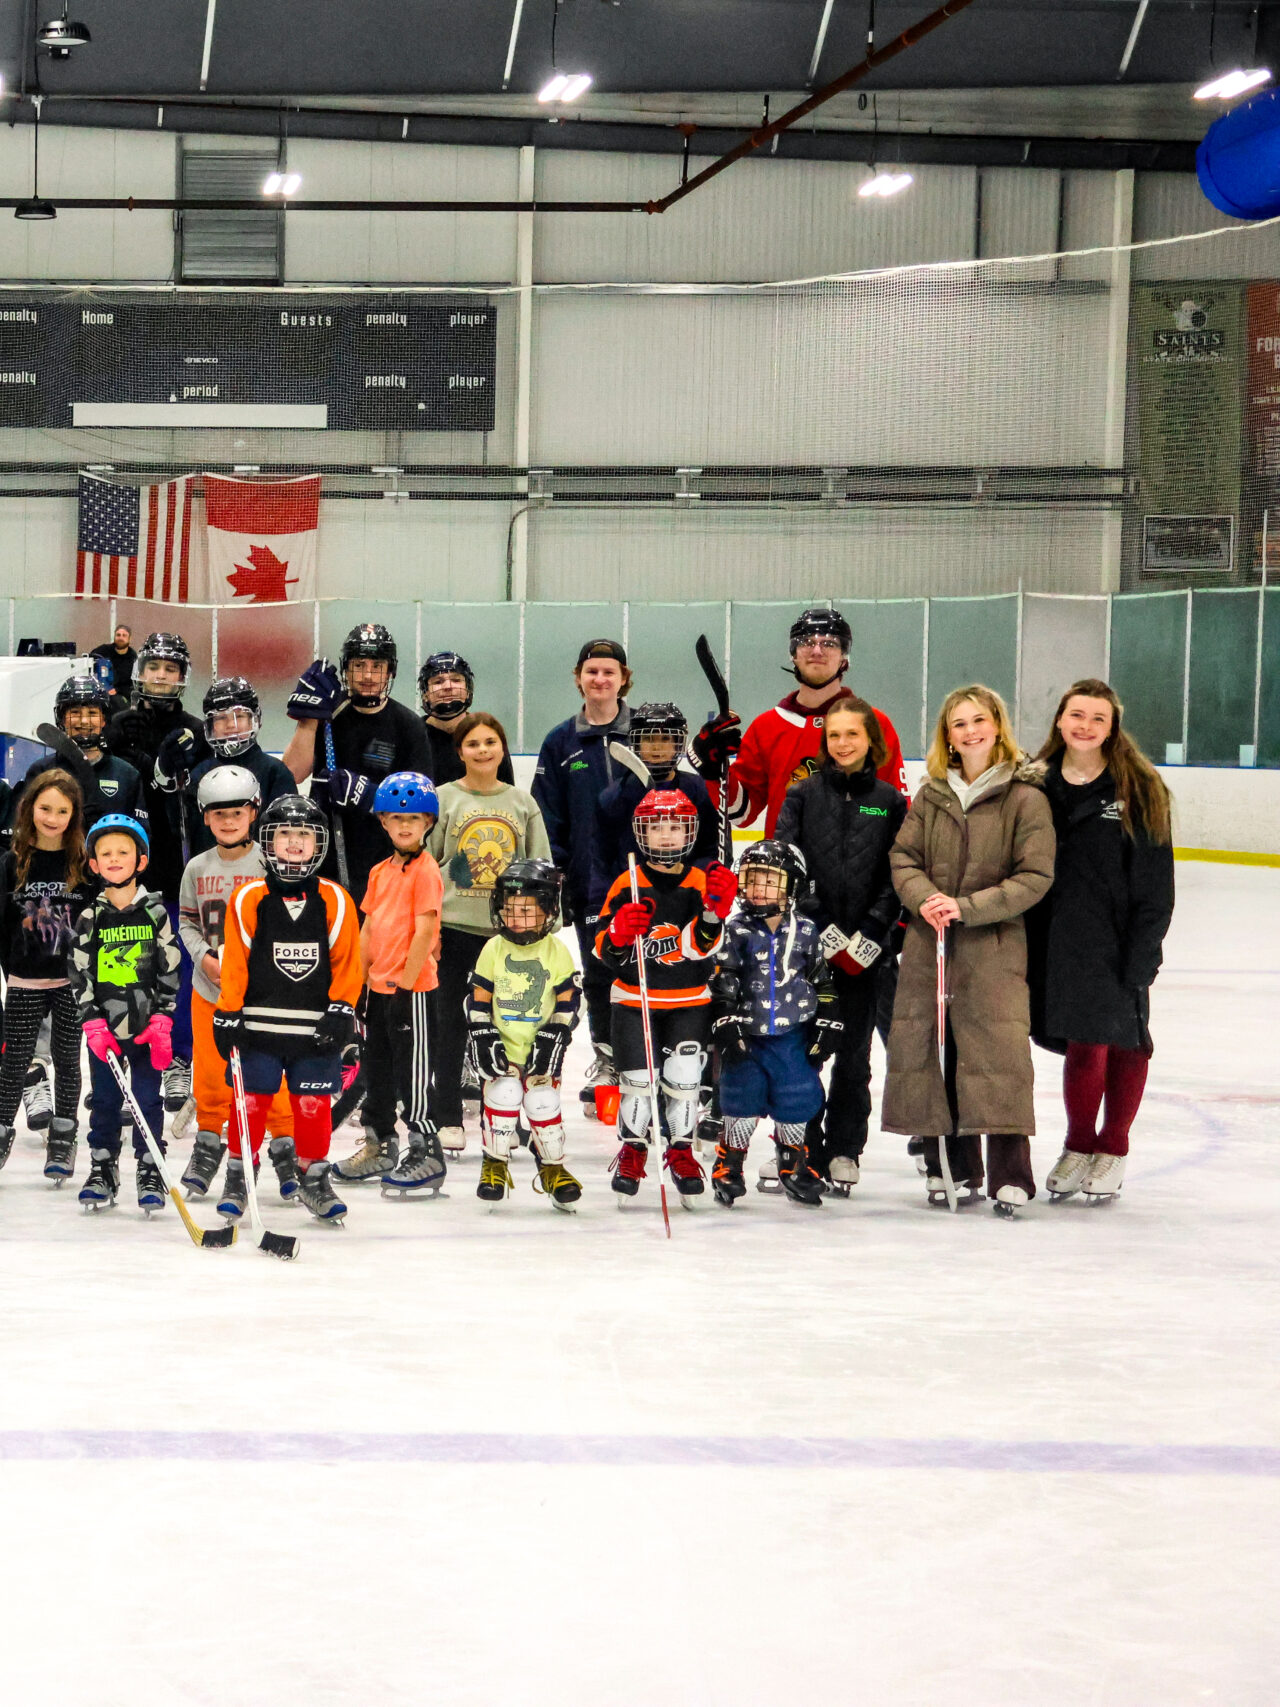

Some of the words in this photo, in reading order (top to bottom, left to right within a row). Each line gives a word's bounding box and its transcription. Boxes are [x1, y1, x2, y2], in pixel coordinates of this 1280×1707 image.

[82, 310, 113, 324] Home
[281, 312, 331, 326] Guests
[366, 312, 406, 327] penalty
[450, 313, 487, 327] player
[1158, 334, 1220, 345] SAINTS
[365, 374, 405, 389] penalty
[449, 375, 486, 389] player
[183, 384, 218, 399] period
[859, 805, 888, 817] PSM
[275, 948, 318, 957] FORCE
[299, 1082, 333, 1090] CCM
